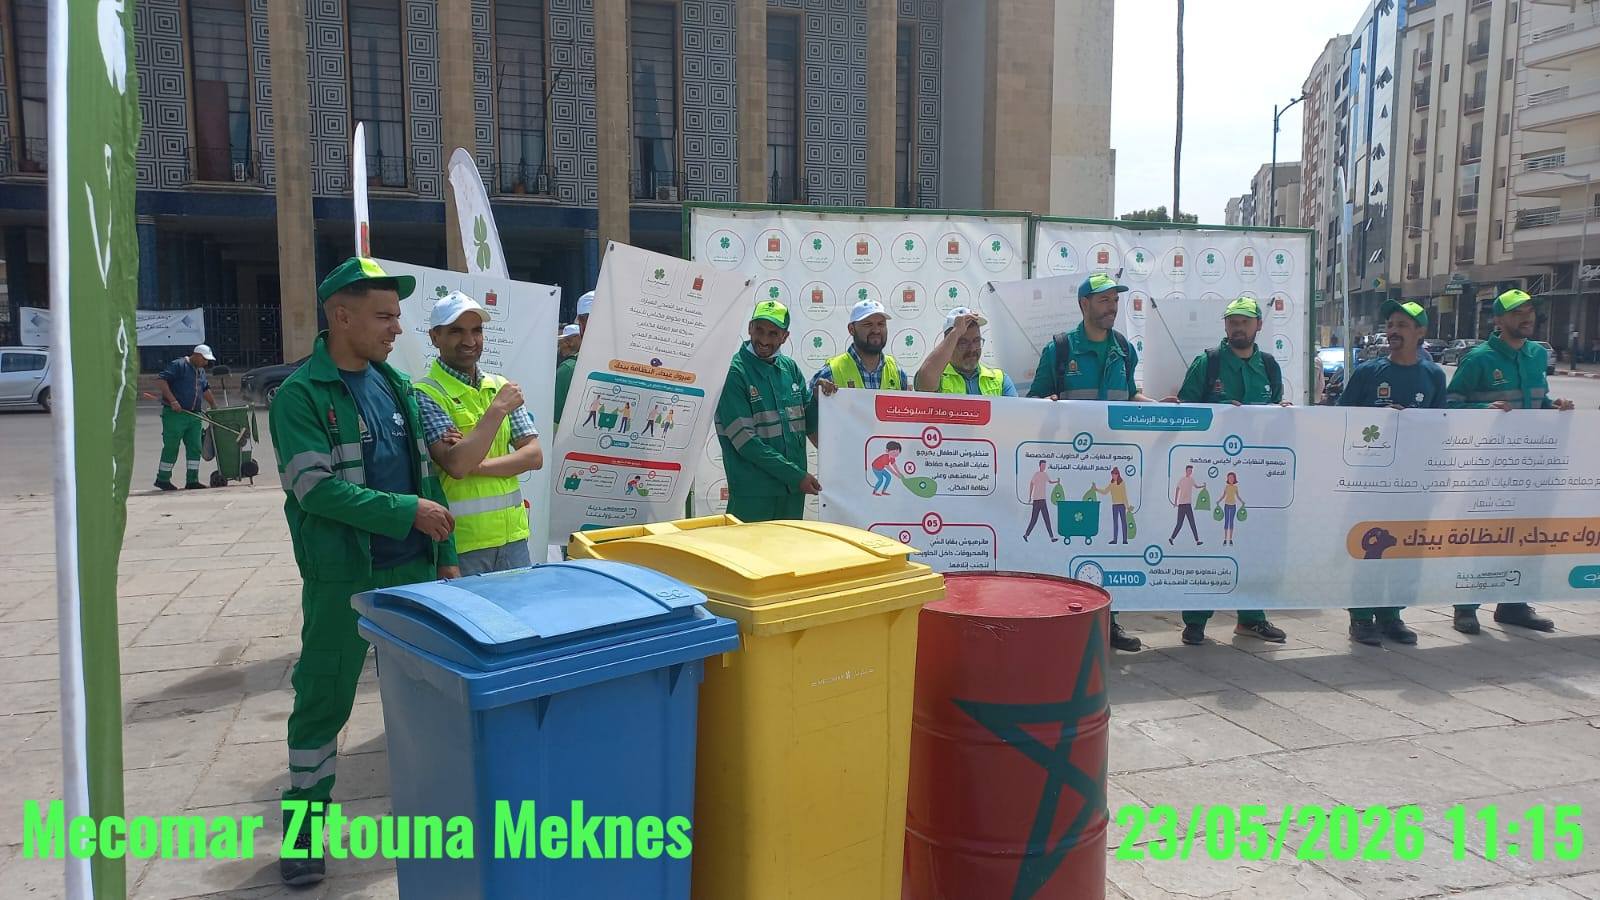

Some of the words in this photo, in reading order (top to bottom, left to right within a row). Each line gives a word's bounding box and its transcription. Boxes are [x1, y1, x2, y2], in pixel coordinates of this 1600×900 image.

[886, 406, 934, 416] السلوكيات
[926, 434, 938, 442] 04
[1078, 438, 1088, 446] 02
[1507, 437, 1522, 446] عيد
[1524, 436, 1558, 446] بمناسبة
[1228, 442, 1238, 450] 01
[1055, 452, 1080, 461] الحاويات
[1080, 454, 1089, 462] في
[1090, 453, 1112, 461] النفايات
[1522, 455, 1545, 467] شركة
[1232, 458, 1242, 466] في
[1242, 458, 1265, 466] النفايات
[1458, 456, 1491, 468] مكناس
[1491, 456, 1520, 468] مكومار
[1072, 463, 1094, 472] النفايات
[977, 472, 990, 480] على
[1394, 478, 1418, 488] حملة
[1452, 477, 1490, 488] المجتمع
[1492, 477, 1524, 489] فعاليات
[1526, 478, 1532, 488] و
[1568, 476, 1594, 486] جماعة
[1472, 497, 1494, 509] شعار
[1496, 498, 1515, 508] تحت
[926, 520, 938, 528] 05
[1447, 526, 1515, 545] النظافة
[1572, 526, 1600, 546] روك
[938, 548, 954, 558] داخل
[954, 549, 988, 558] والمحروقات
[1148, 552, 1159, 560] 03
[1171, 568, 1184, 576] رجال
[1217, 568, 1232, 576] باش
[1108, 574, 1140, 584] 14H00
